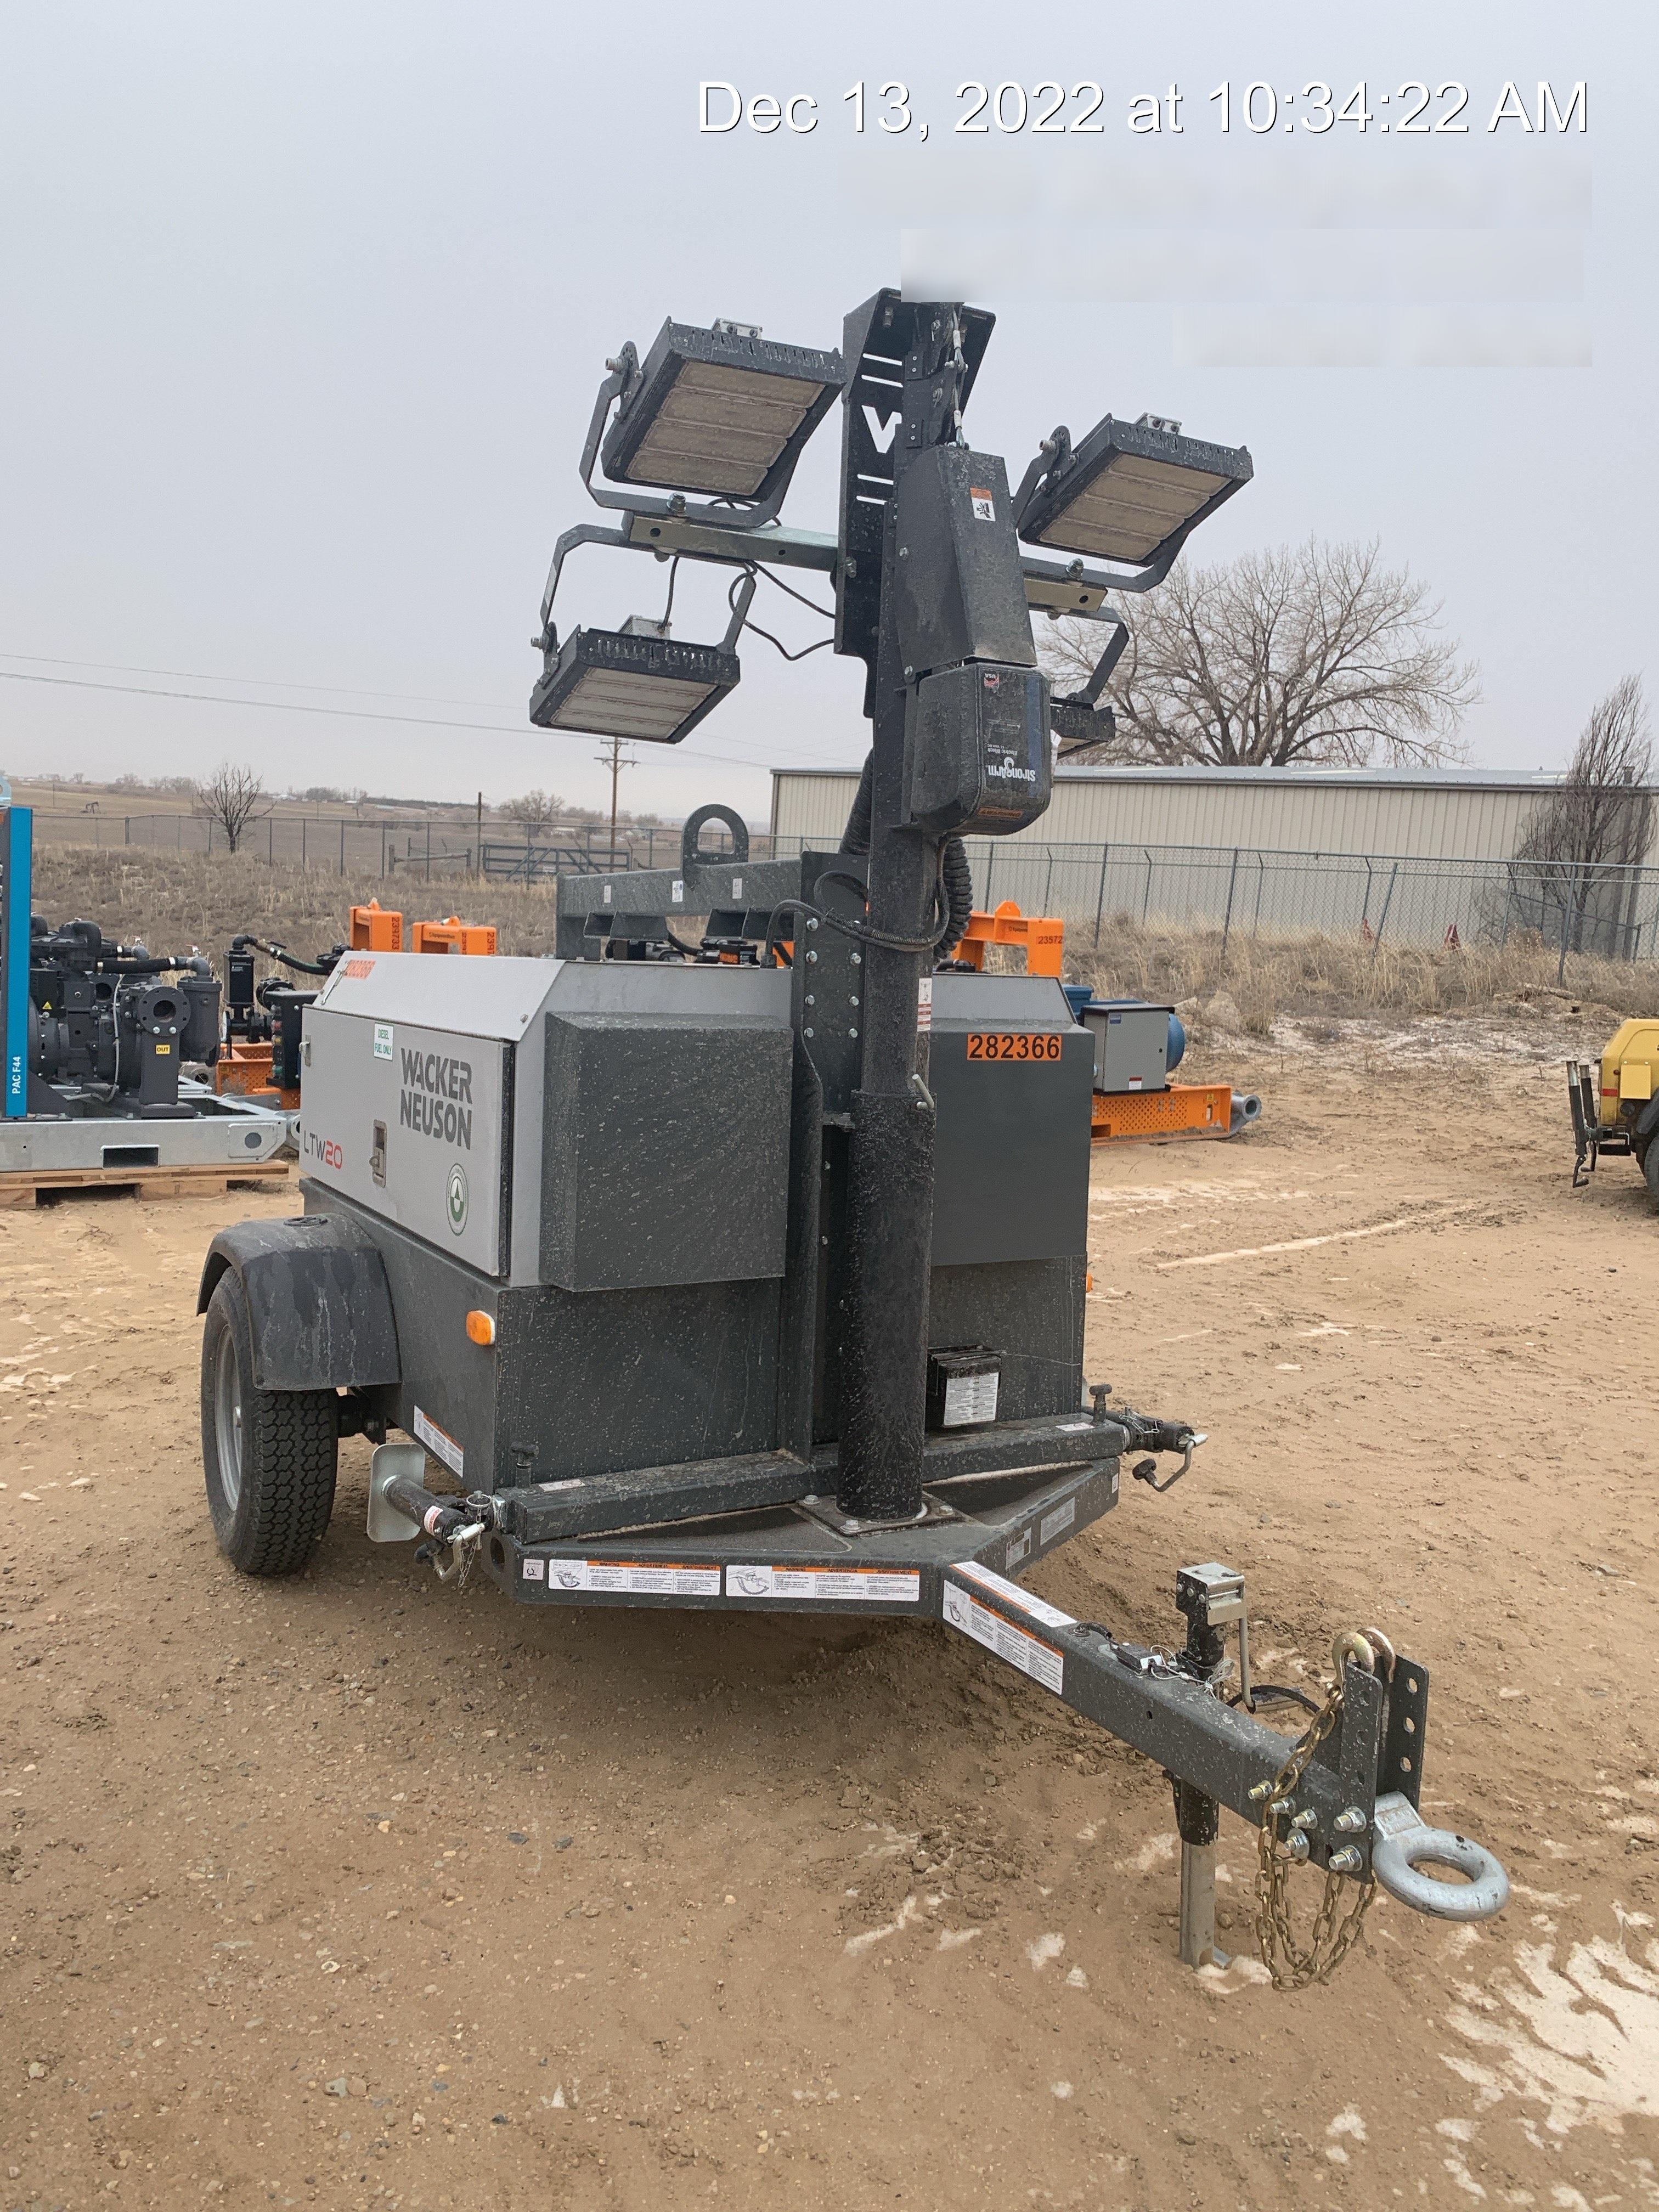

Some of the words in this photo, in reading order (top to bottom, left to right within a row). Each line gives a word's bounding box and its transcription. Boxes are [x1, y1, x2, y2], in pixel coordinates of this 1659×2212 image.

[988, 757, 1036, 782] StrongArm
[392, 917, 400, 950] 239733
[378, 1029, 389, 1040] DIESEL
[383, 1044, 392, 1055] ONLY
[969, 1035, 1060, 1059] 282366
[12, 1056, 21, 1073] F44
[400, 1047, 473, 1104] WACKER
[12, 1075, 21, 1094] PAC
[400, 1089, 472, 1150] NEUSON
[304, 1130, 343, 1170] LTW20
